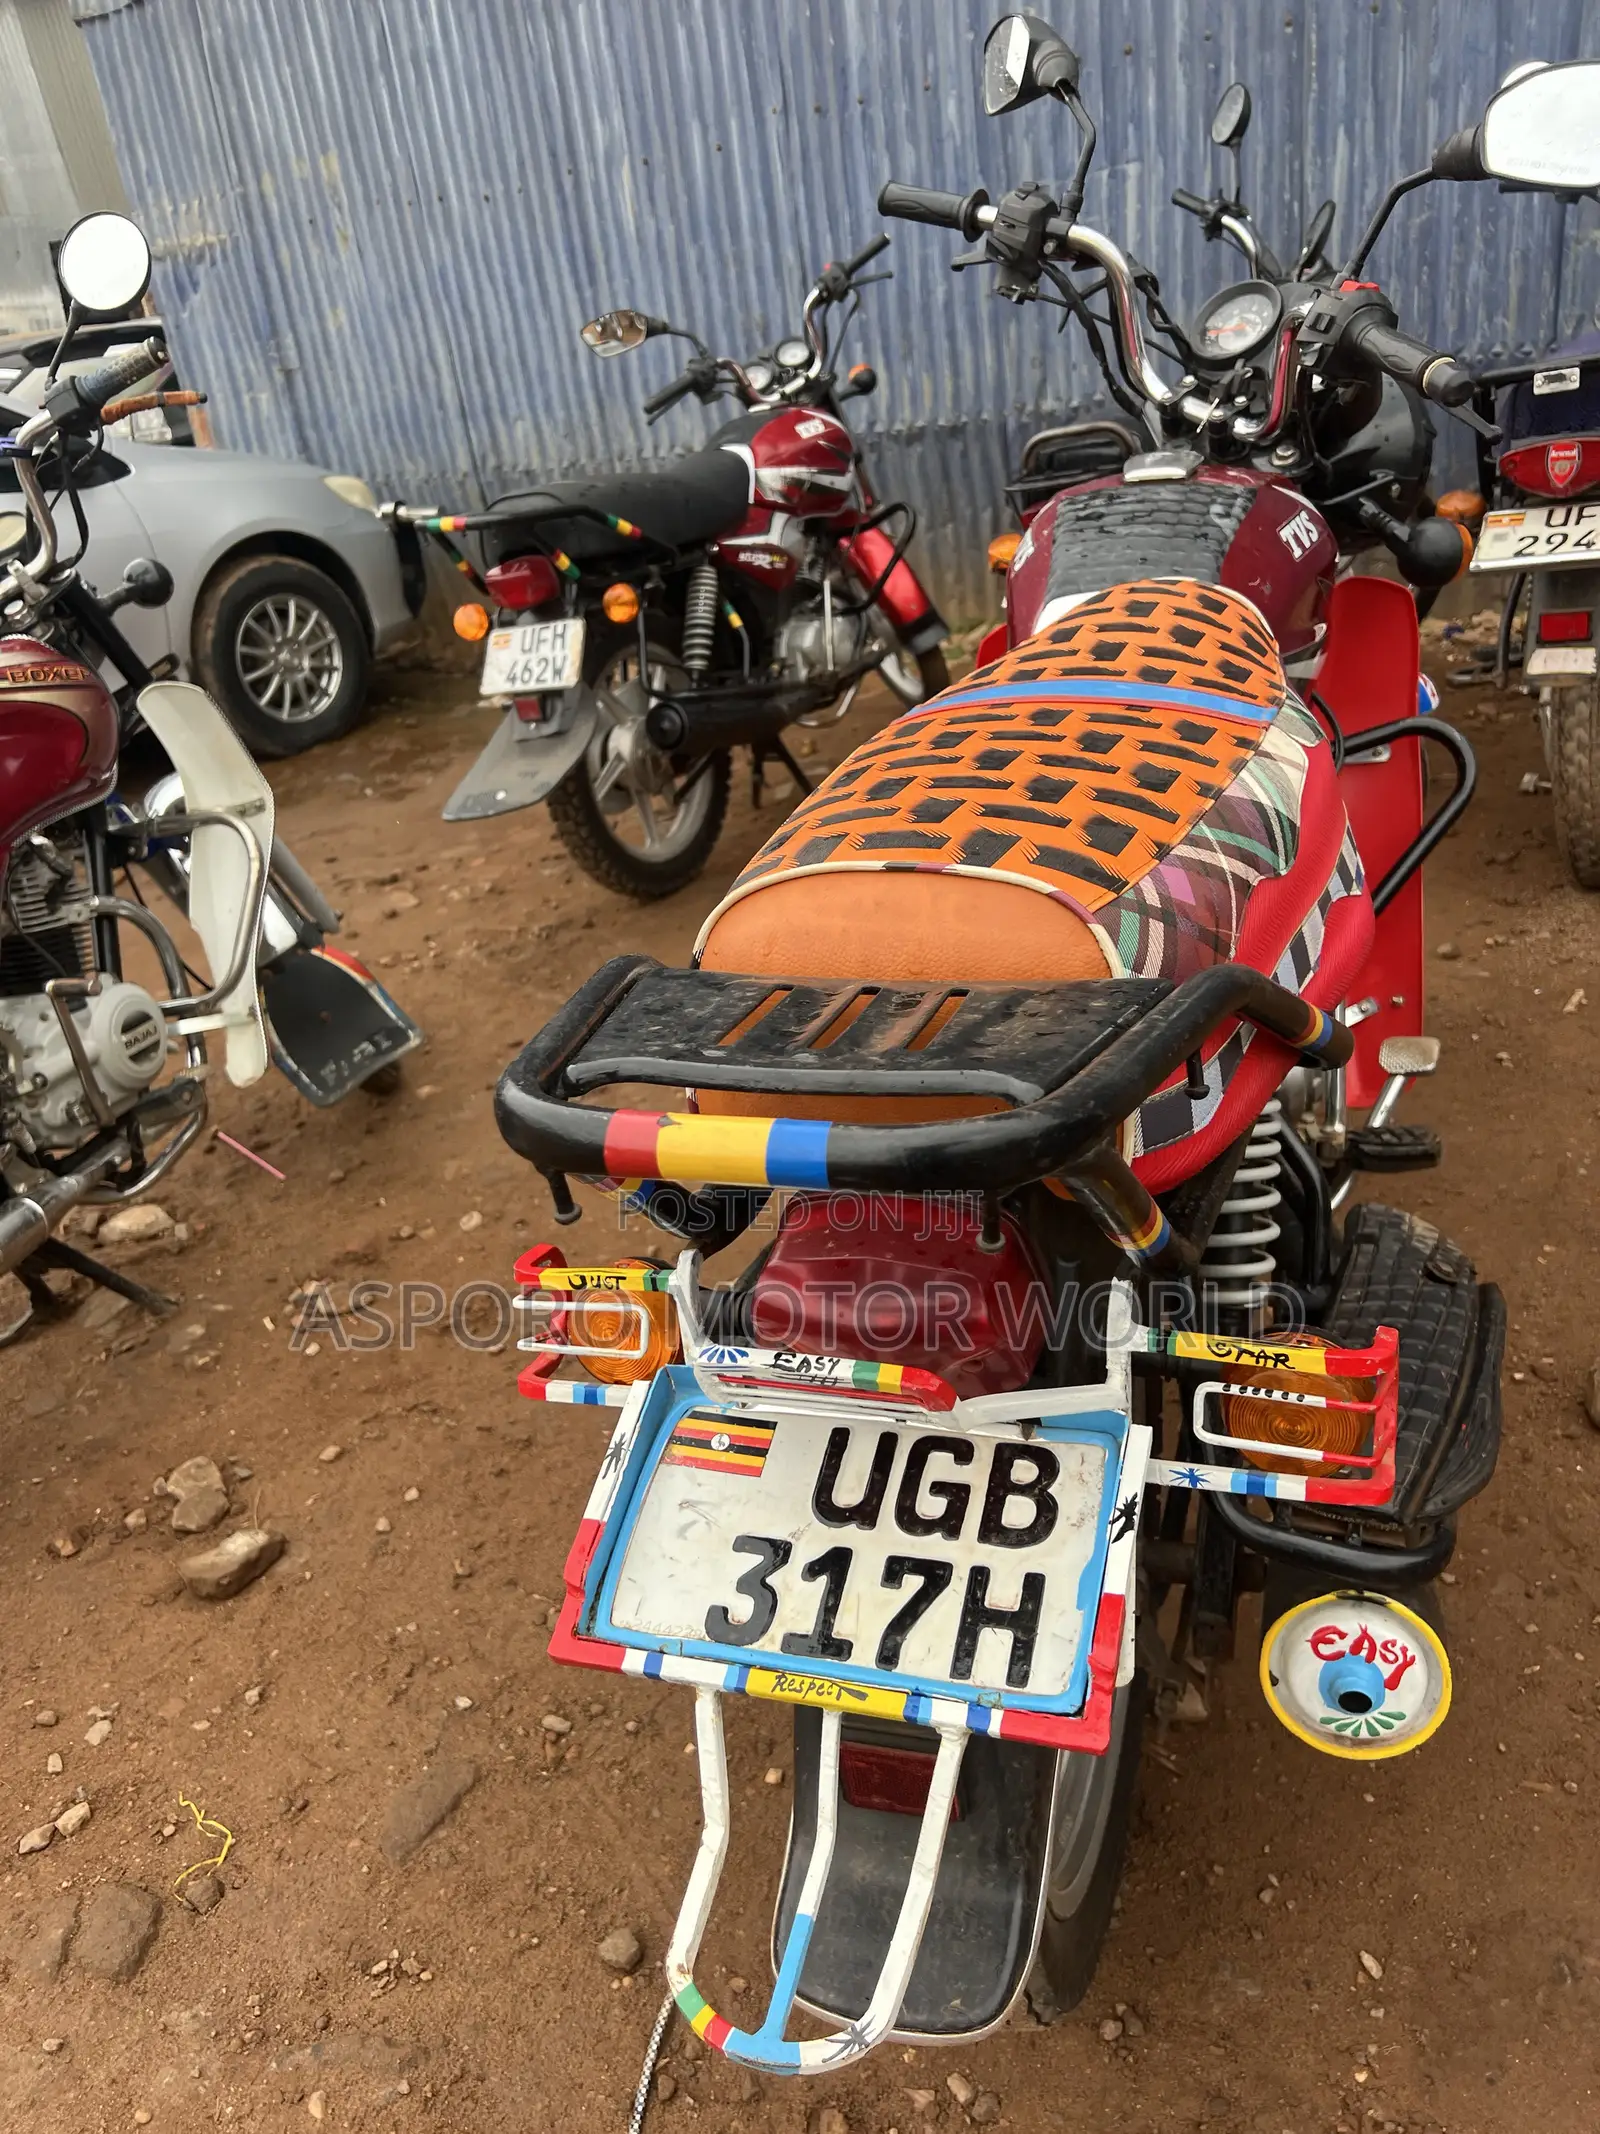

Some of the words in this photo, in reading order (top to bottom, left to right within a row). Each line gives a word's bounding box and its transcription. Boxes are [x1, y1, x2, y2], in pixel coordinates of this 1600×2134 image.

[1545, 504, 1600, 528] UF
[1280, 510, 1319, 559] TVS
[1513, 529, 1599, 557] 294
[521, 623, 567, 654] UFH
[506, 655, 568, 687] 462W
[768, 1352, 841, 1375] EASY
[1206, 1339, 1296, 1370] STAR
[811, 1427, 1061, 1549] UGB
[704, 1534, 1047, 1688] 317H
[1305, 1623, 1416, 1691] EASY
